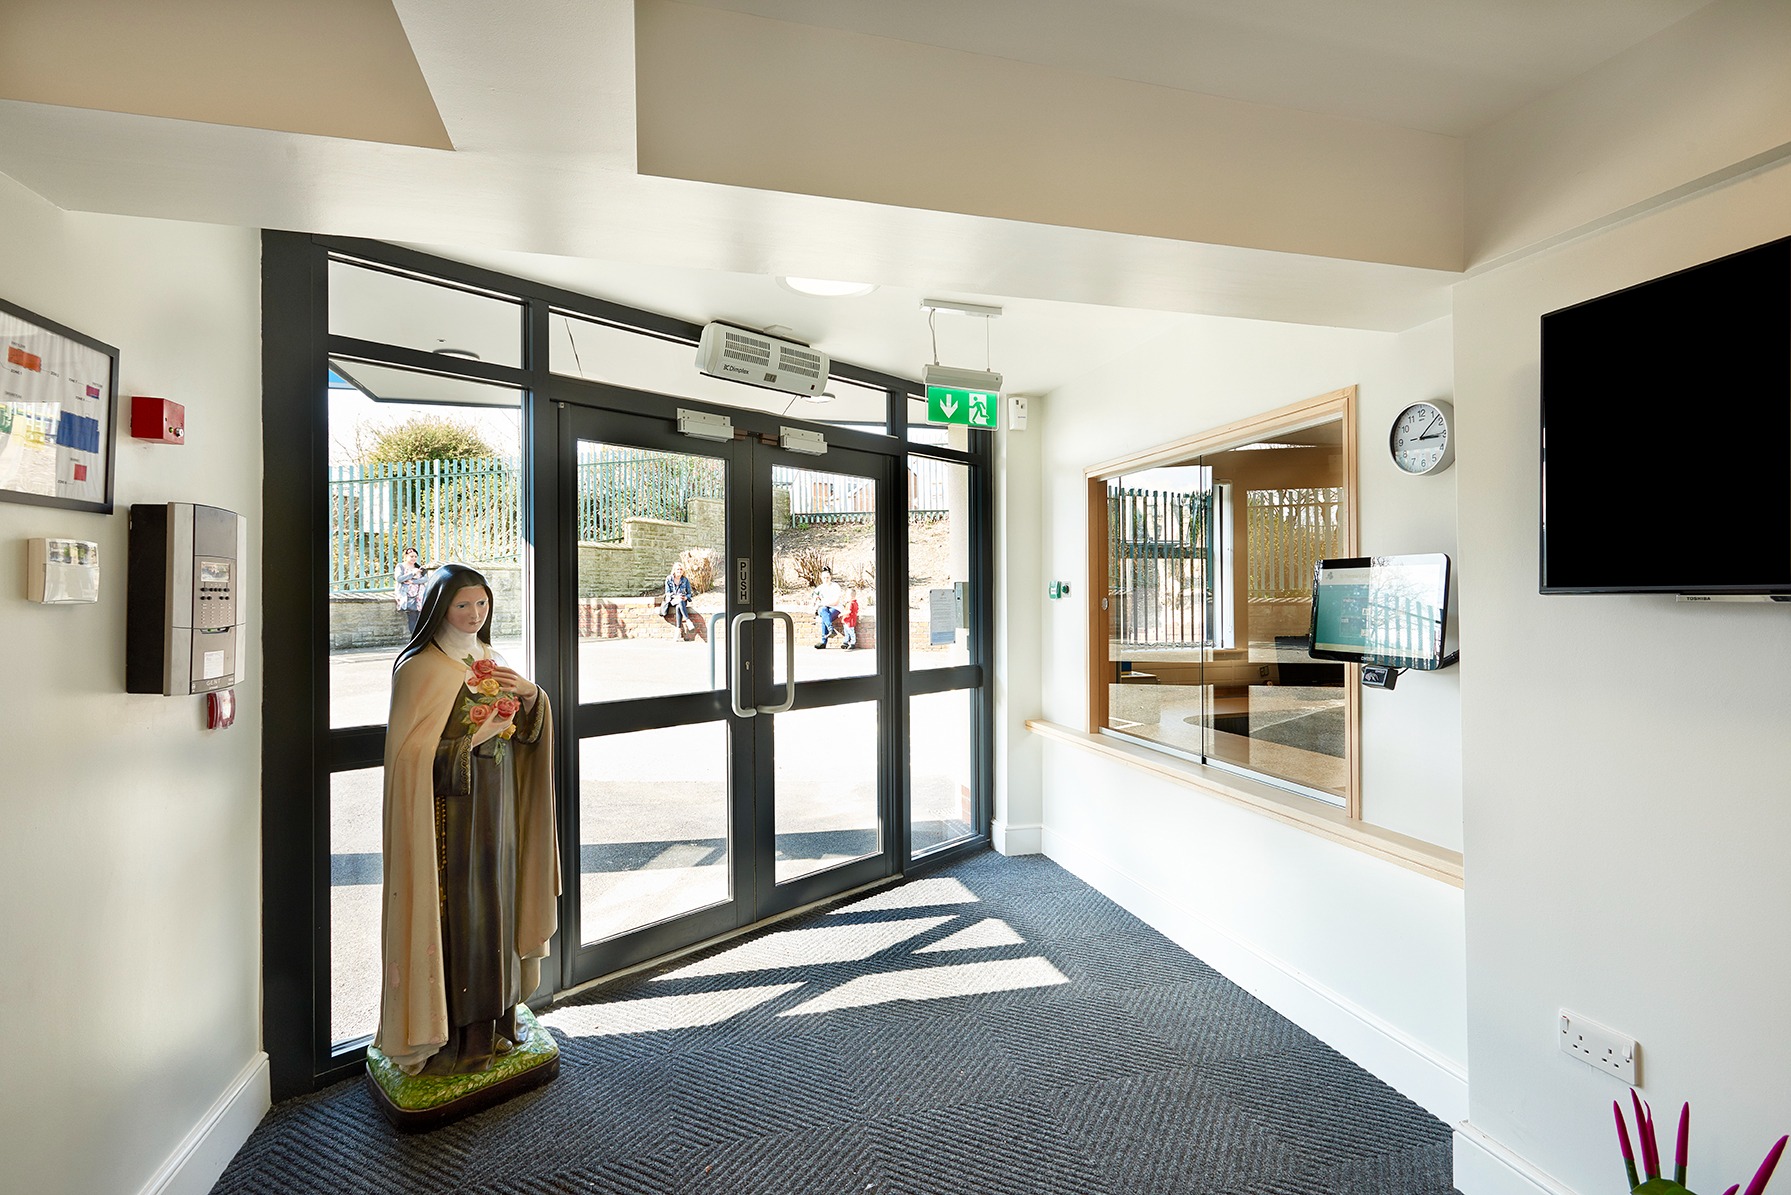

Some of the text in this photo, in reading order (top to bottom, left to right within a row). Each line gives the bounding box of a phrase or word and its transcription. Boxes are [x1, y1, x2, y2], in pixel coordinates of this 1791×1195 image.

[729, 365, 749, 375] Dimplex
[1417, 408, 1426, 418] 12
[1431, 410, 1435, 418] 1
[1408, 415, 1415, 423] 11
[1438, 417, 1444, 426] 2
[1401, 424, 1410, 433] 10
[1442, 429, 1447, 438] 3
[1398, 438, 1404, 447] 9
[1439, 443, 1444, 451] 4
[1402, 449, 1408, 458] 8
[1431, 453, 1437, 462] 5
[1411, 457, 1416, 466] 7
[1421, 459, 1426, 468] 6
